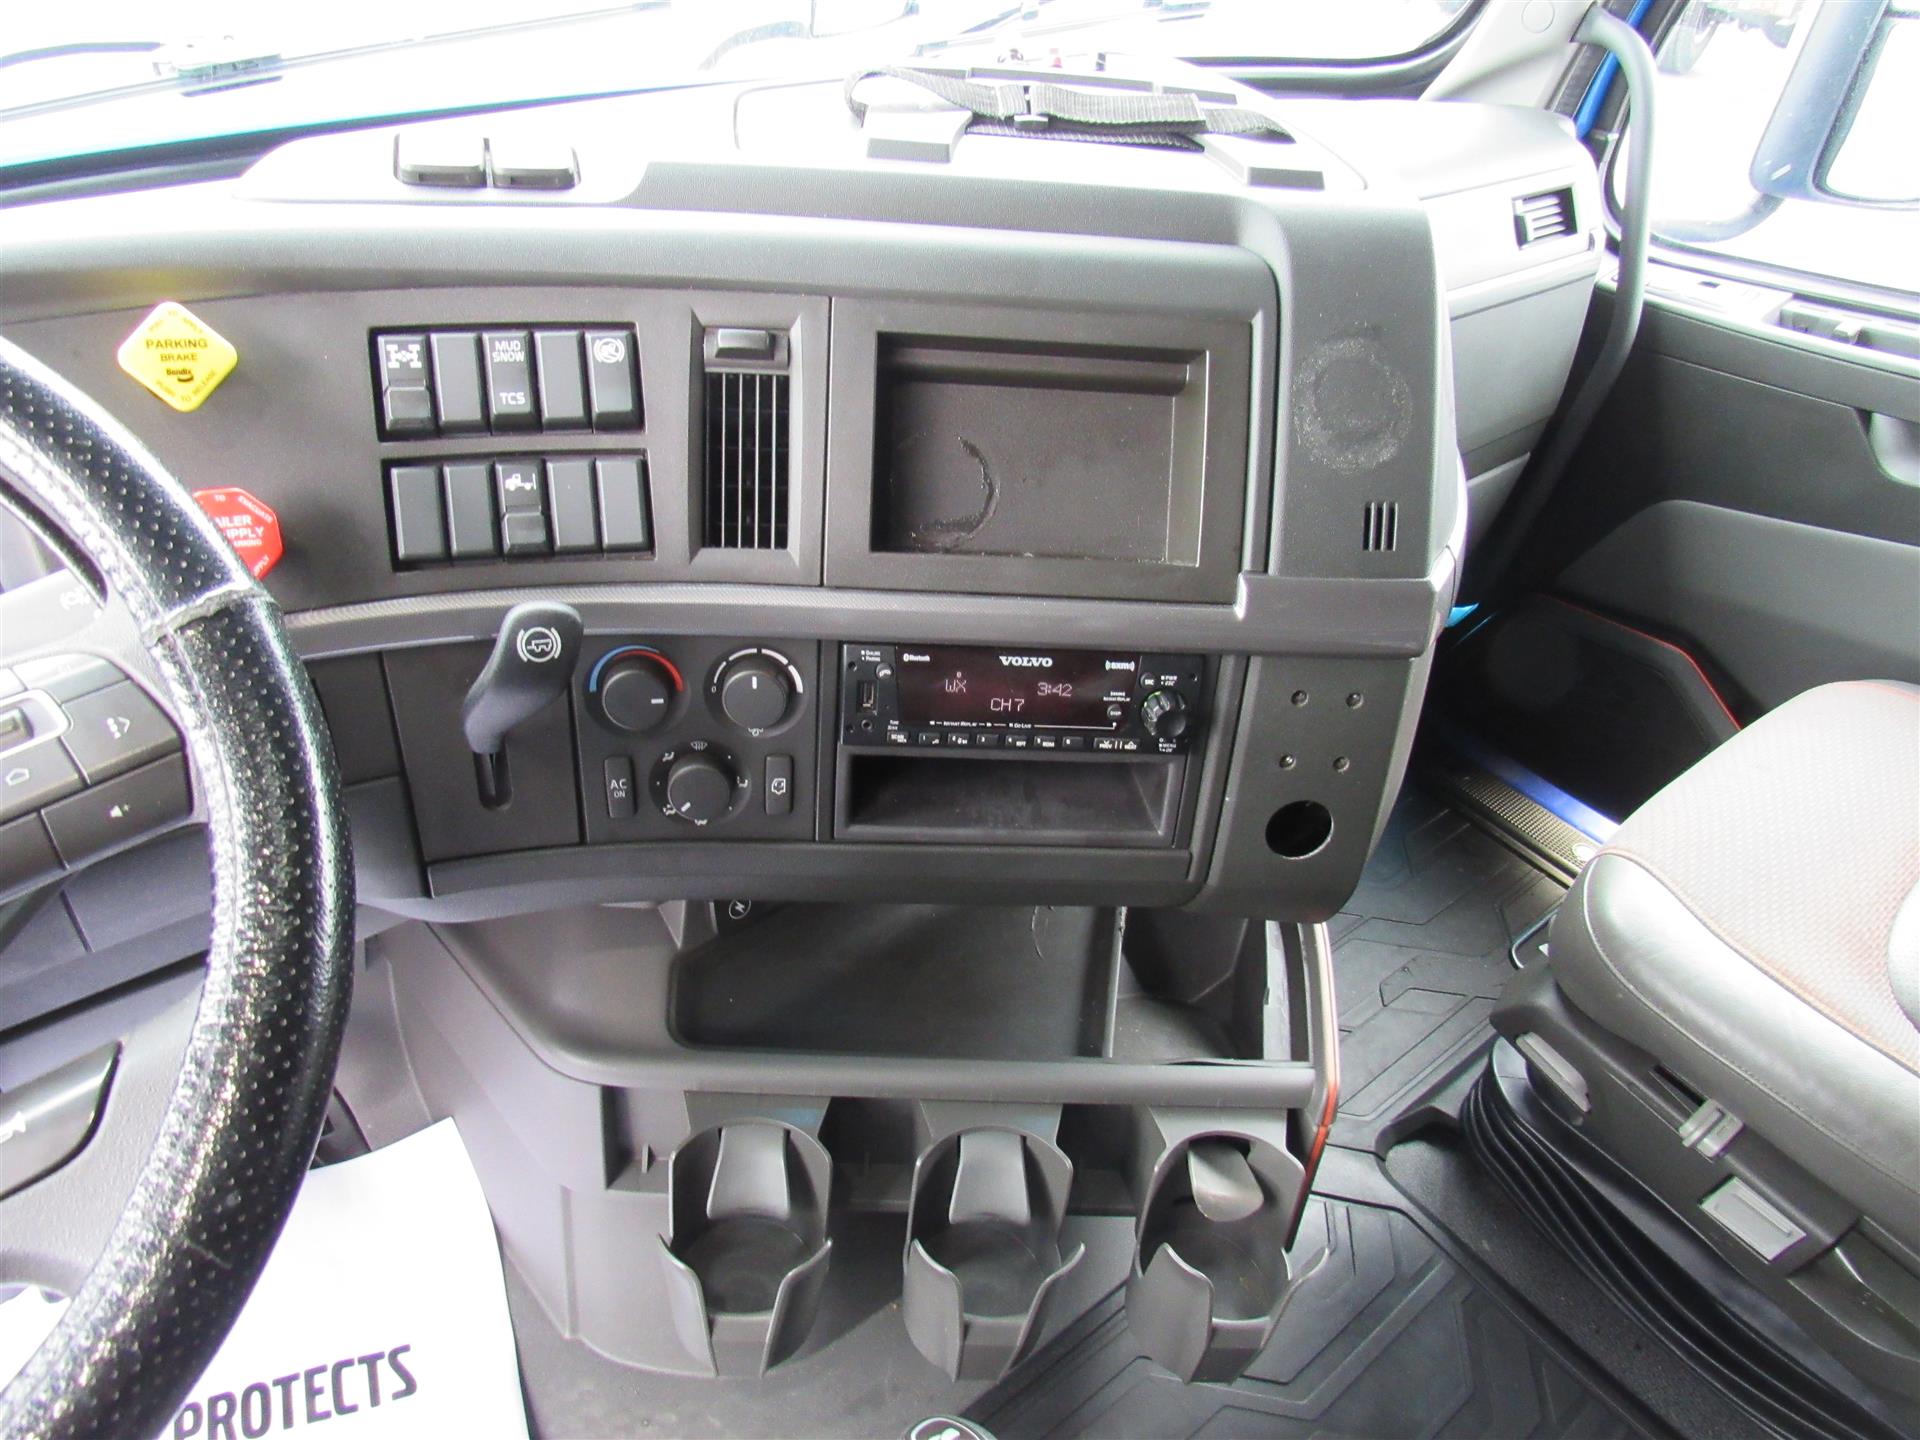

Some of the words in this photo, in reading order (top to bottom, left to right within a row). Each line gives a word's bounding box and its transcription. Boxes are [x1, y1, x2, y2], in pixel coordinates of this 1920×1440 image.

[145, 338, 208, 350] PARKING
[495, 340, 521, 351] MUD
[160, 353, 198, 362] BRAKE
[492, 351, 525, 363] SNOW
[499, 392, 526, 405] TCS
[999, 655, 1053, 667] VOLVO
[945, 679, 967, 693] WX
[1037, 681, 1073, 697] 3:42
[613, 790, 626, 798] ON
[174, 1344, 417, 1440] PROTECTS
